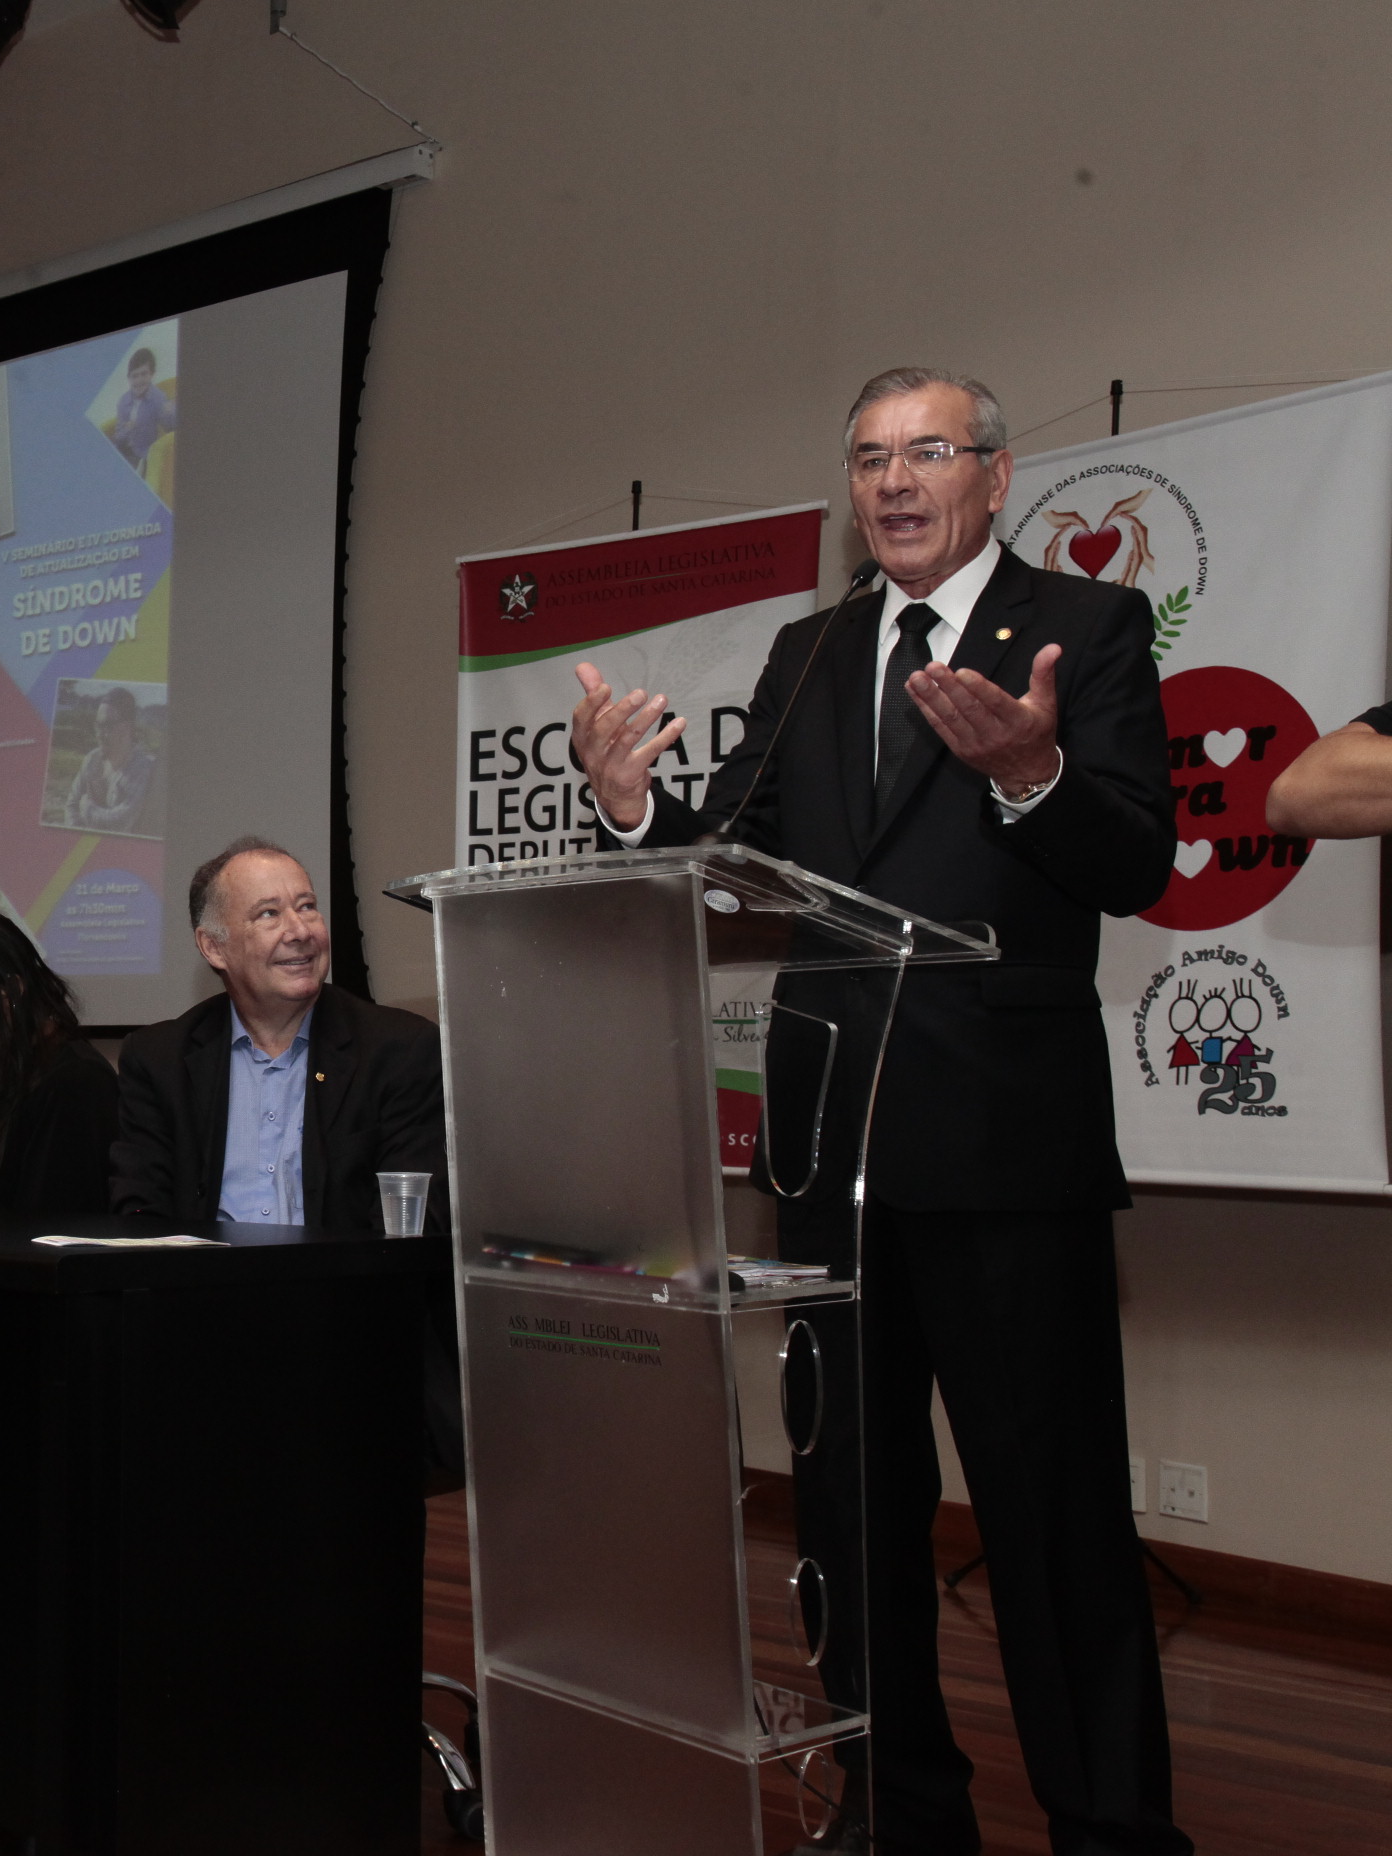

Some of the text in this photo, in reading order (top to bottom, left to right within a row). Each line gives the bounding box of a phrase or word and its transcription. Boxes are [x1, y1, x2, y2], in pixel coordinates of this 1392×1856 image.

[102, 522, 163, 544] JORNADA
[1007, 464, 1208, 596] ATARINENSE DAS ASSOCIAÇÕES DE SÍNDROME DE DOWN
[19, 564, 35, 579] DE
[120, 545, 140, 560] EM
[546, 542, 776, 588] ASSEMBLEIA LEGISLATIVA
[12, 572, 144, 620] SÍNDROME
[545, 567, 777, 609] DO ESTADO DE SANTA CATARINA
[20, 614, 139, 657] DE DOWN
[469, 706, 750, 783] ESCA D
[1133, 964, 1176, 1087] Associação
[1181, 944, 1248, 967] Amigo
[1198, 1047, 1277, 1116] 25
[1241, 1105, 1288, 1117] anos
[510, 1336, 662, 1367] DO ESTADO DE SANTA CATARINA
[582, 1322, 661, 1347] LEGISLATIVA
